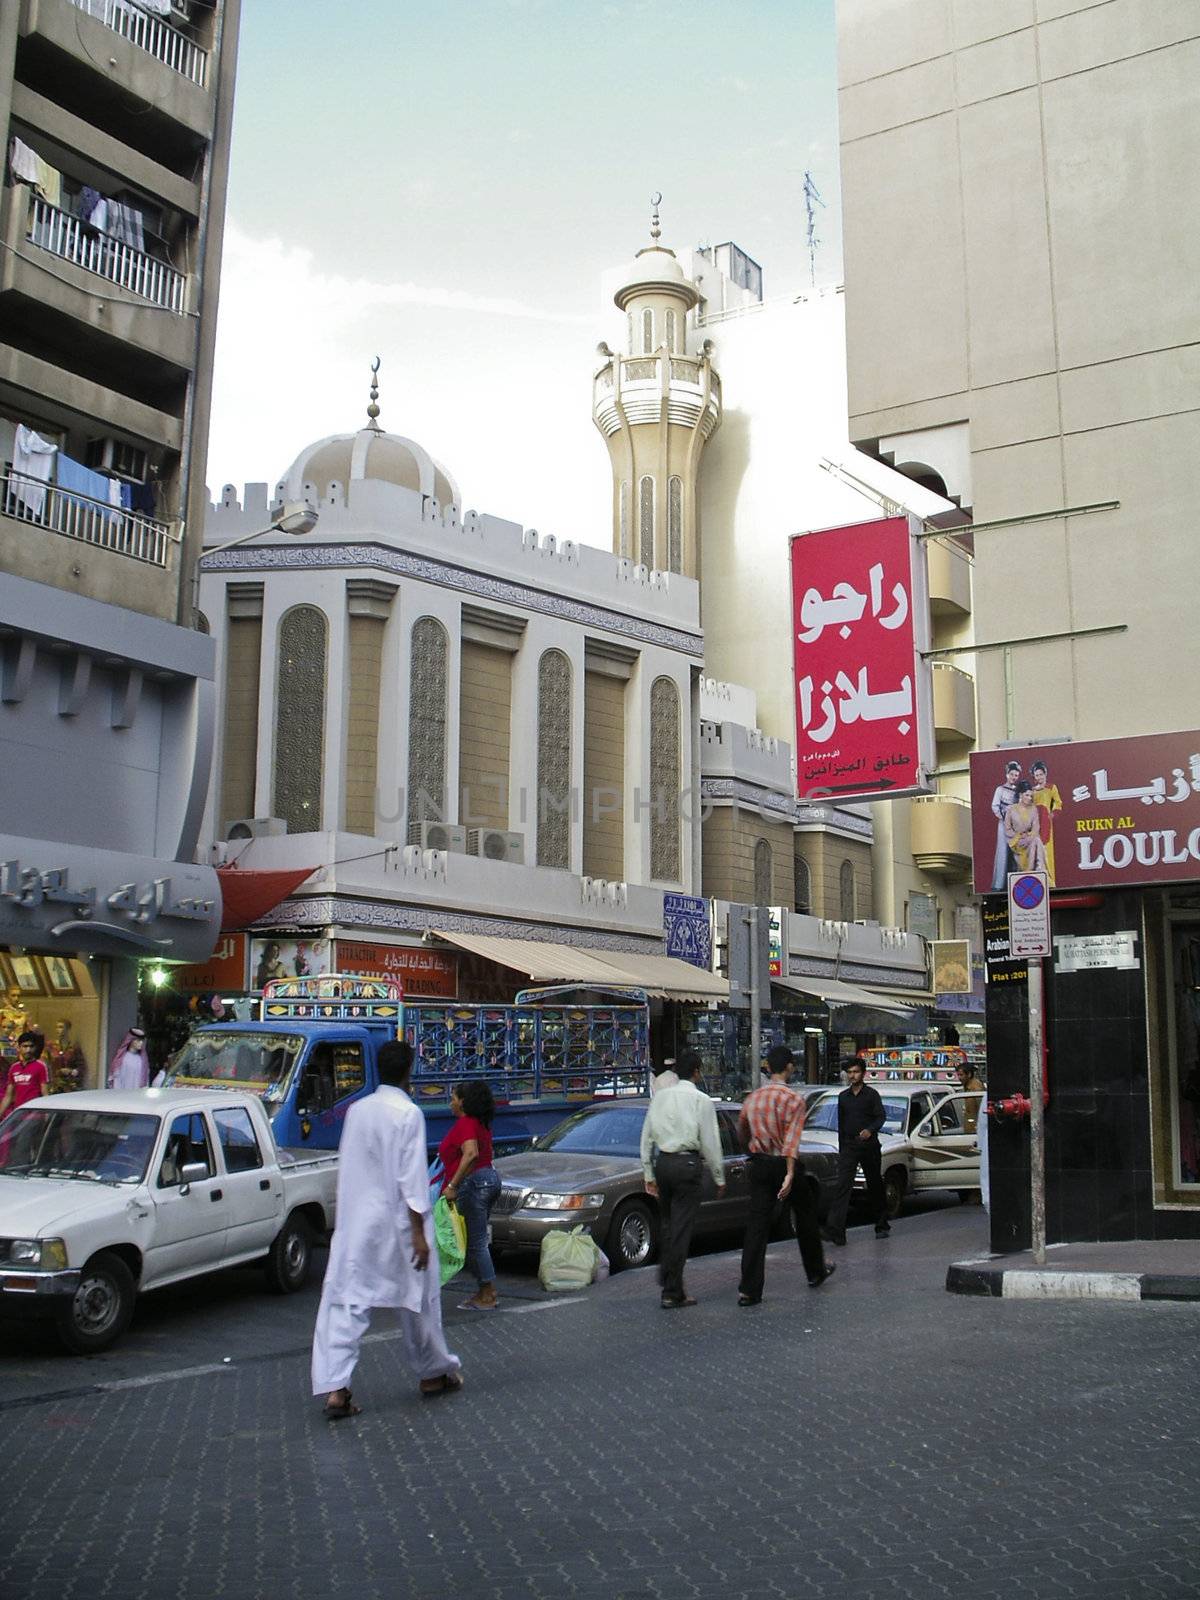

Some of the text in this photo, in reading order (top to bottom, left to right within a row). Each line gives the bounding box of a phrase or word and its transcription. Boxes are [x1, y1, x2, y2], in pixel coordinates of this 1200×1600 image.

[798, 562, 908, 643] راجو
[799, 666, 913, 742] بلازا
[873, 753, 910, 772] طابق
[1076, 817, 1135, 832] RUKN AL
[992, 973, 1009, 981] Flat
